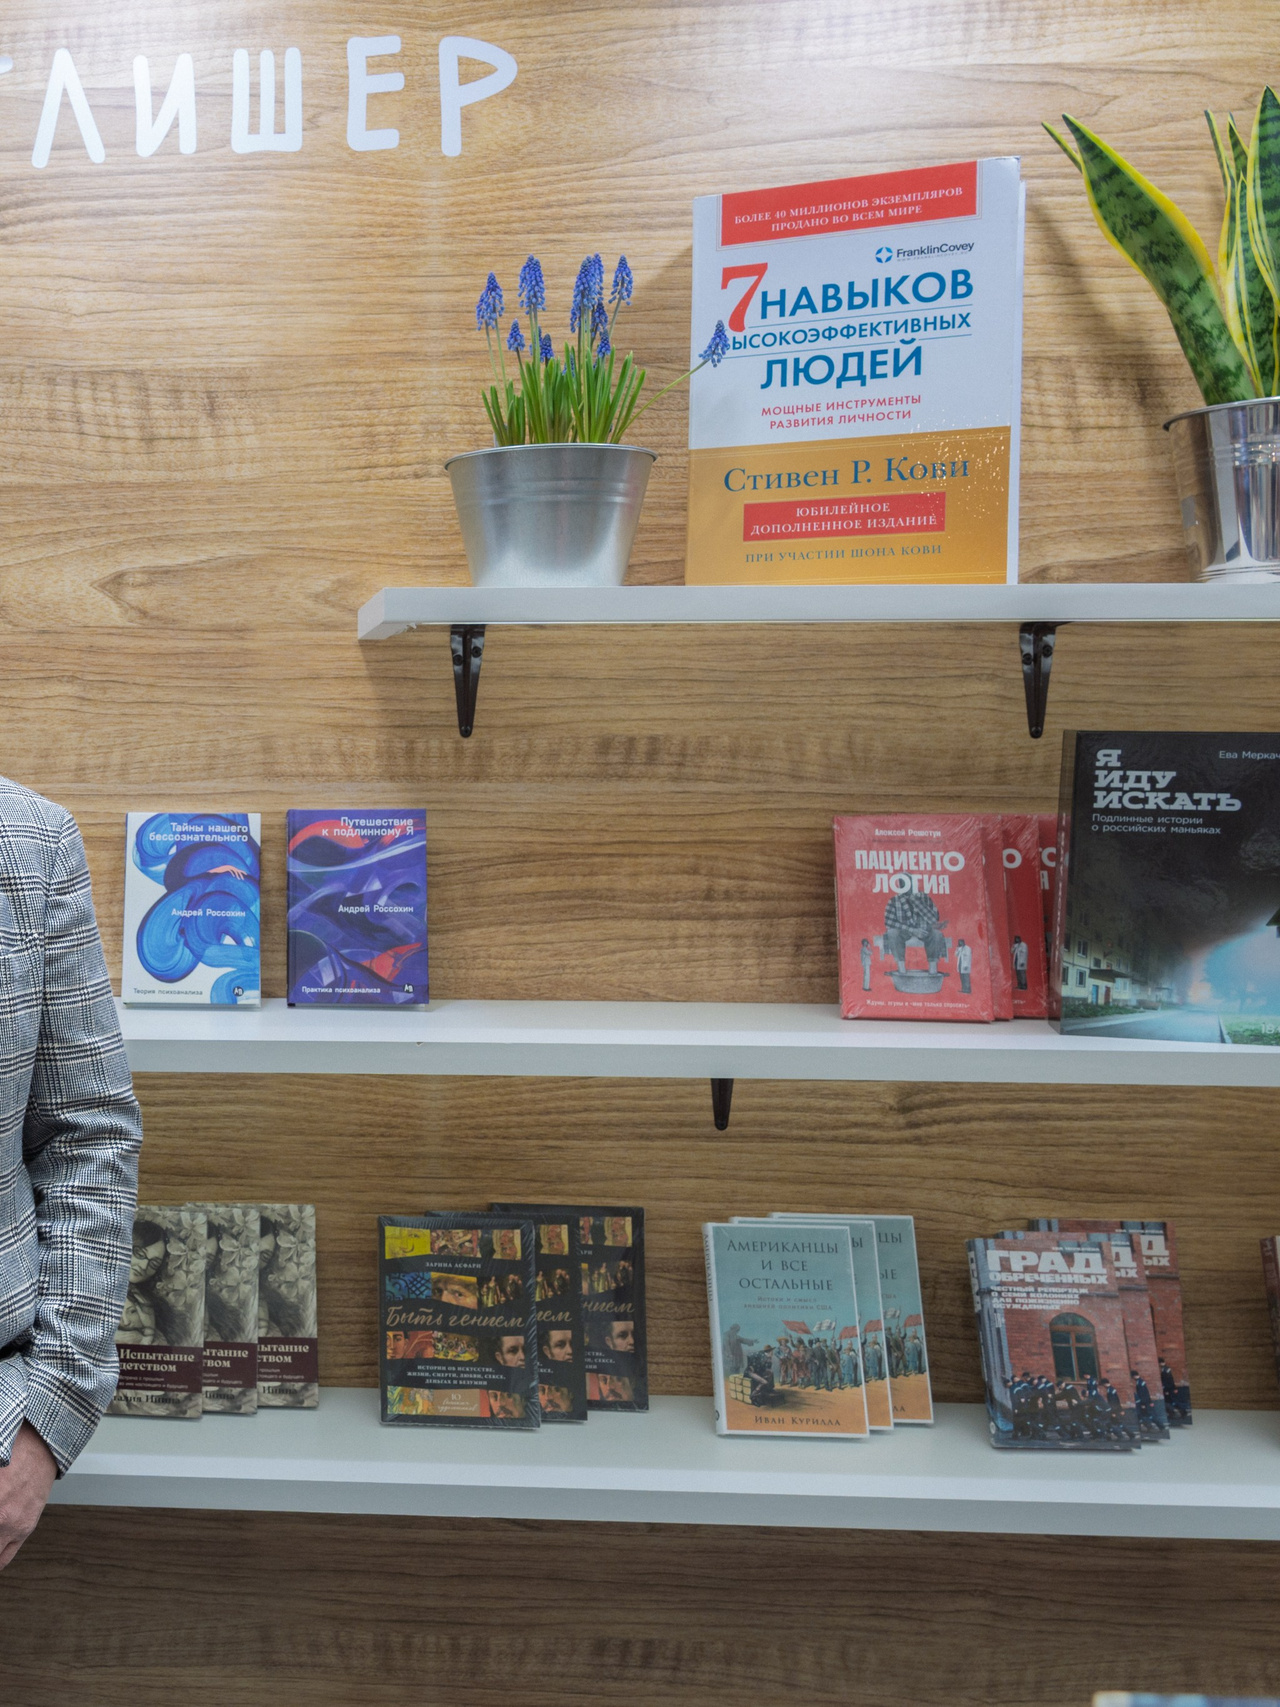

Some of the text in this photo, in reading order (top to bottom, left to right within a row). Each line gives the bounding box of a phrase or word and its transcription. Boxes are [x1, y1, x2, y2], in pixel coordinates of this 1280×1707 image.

[734, 186, 964, 225] БОЛЕЕ 40 МИЛЛИОНОВ ЭКЗЕМПЛЯРОВ
[771, 205, 923, 232] ПРОДАНО ВО ВСЕМ МИРЕ
[896, 242, 975, 258] FranklinCovey
[721, 262, 974, 333] 7 НАВЫКОВ
[731, 312, 972, 351] ЫСОКОЭФФЕКТИВНЫХ
[760, 337, 922, 390] ЛЮДЕЙ
[761, 394, 921, 417] МОЩНЫЕ ИНСТРУМЕНТЫ
[769, 409, 911, 430] РАЗВИТИЯ ЛИЧНОСТИ
[723, 456, 970, 493] Стивен Р. Кови
[796, 502, 891, 517] ЮБИЛЕЙНОЕ
[750, 514, 938, 536] ДОПОЛНЕННОЕ ИЗДАНИЕ
[745, 544, 942, 563] ПРИ УЧАСТИИ ШОНА КОВИ
[1095, 749, 1122, 767] Я
[1218, 751, 1238, 759] Ева
[1094, 769, 1177, 791] ИДУ
[1093, 790, 1242, 812] ИСКАТЬ
[340, 816, 414, 828] Путешествие
[1092, 813, 1203, 825] Подлинные истории
[170, 822, 248, 833] Тайны нашего
[322, 826, 414, 838] к подлинному Я
[1103, 823, 1166, 834] российских
[1171, 825, 1221, 834] маньяках
[149, 832, 248, 842] бессознательного
[854, 850, 965, 873] ПАЦИЕНТО
[872, 873, 950, 894] ЛОГИЯ
[171, 908, 246, 918] Андрей Россохин
[338, 904, 414, 914] Андрей Россохин
[301, 986, 332, 994] Практика
[727, 1240, 839, 1254] АМЕРИКАНЦЫ
[761, 1260, 808, 1271] И ВСЕ
[986, 1250, 1107, 1274] ГРАД
[739, 1278, 833, 1291] ОСТАЛЬНЫЕ
[386, 1305, 443, 1327] Быть
[448, 1313, 525, 1328] гением
[120, 1348, 195, 1362] Испытание
[202, 1348, 249, 1358] ытание
[257, 1344, 310, 1353] ытание
[754, 1416, 841, 1426] ИВАН КУРИЛЛА
